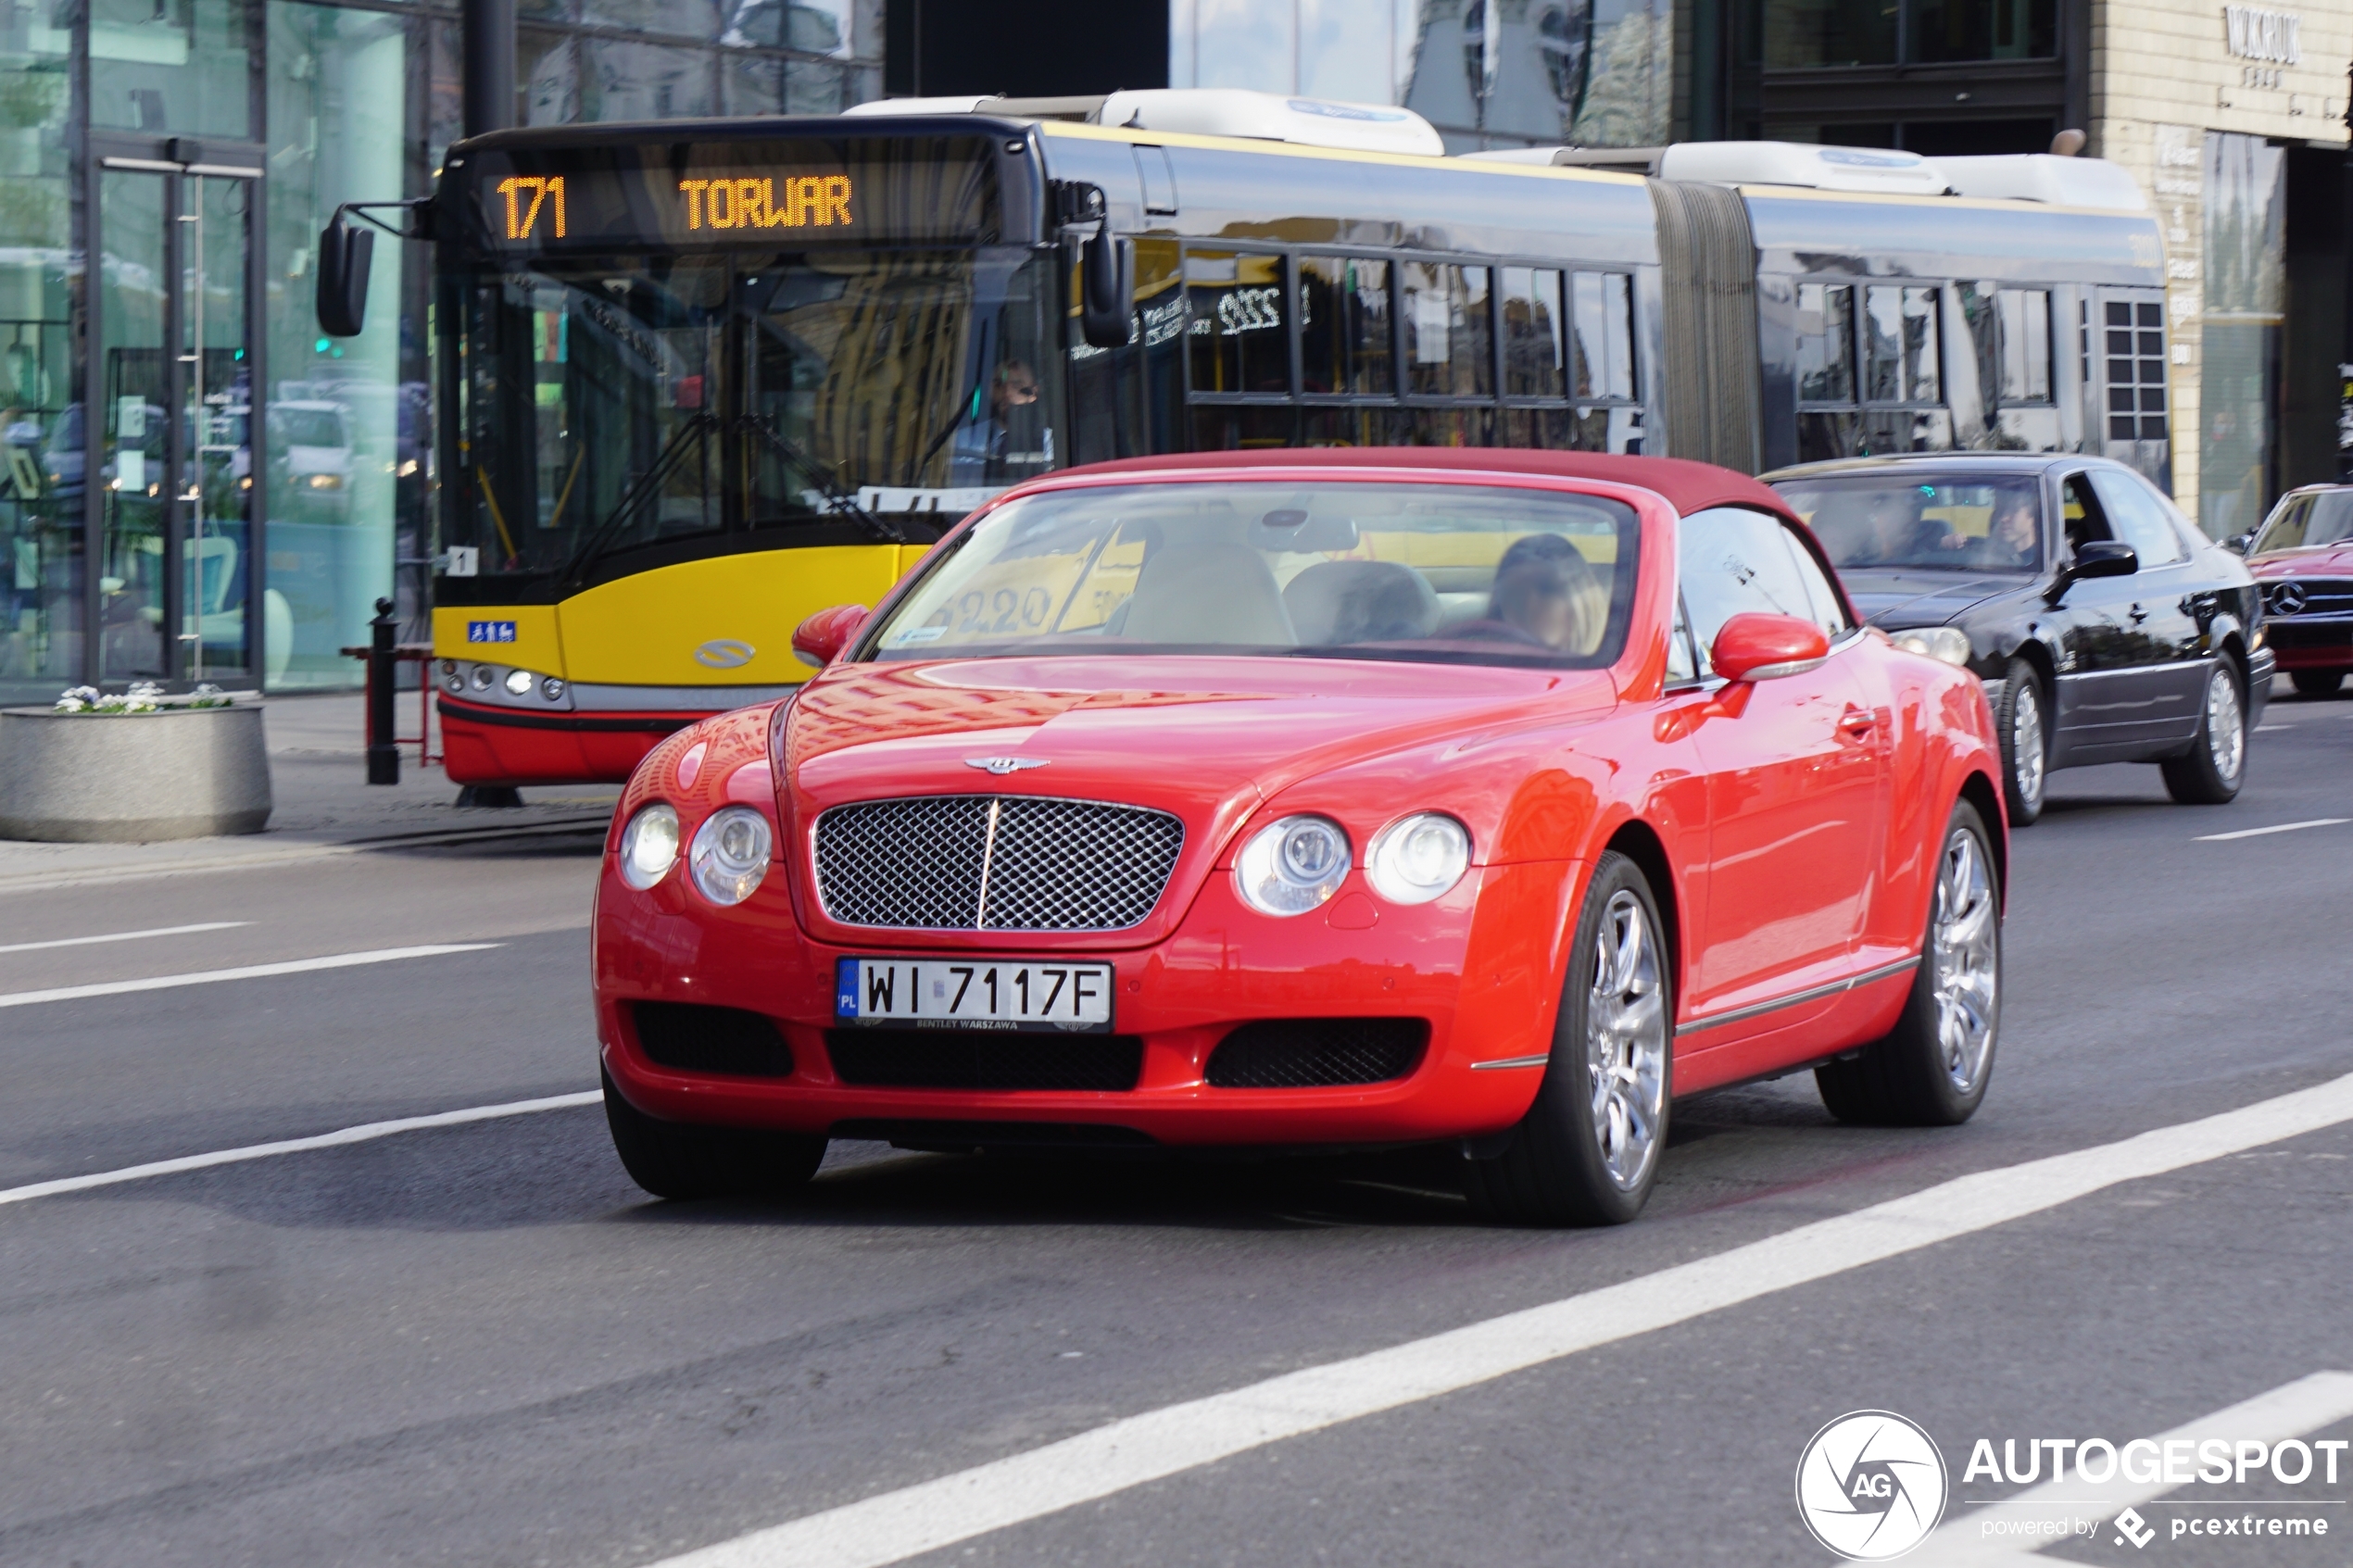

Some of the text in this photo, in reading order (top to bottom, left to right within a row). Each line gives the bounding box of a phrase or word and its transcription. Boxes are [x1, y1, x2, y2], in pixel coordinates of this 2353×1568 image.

[497, 175, 852, 240] 171 TORWAR
[841, 995, 856, 1009] PL
[867, 966, 1101, 1016] WI 7117F
[917, 1019, 1018, 1030] BENTLEY WARSZAWA
